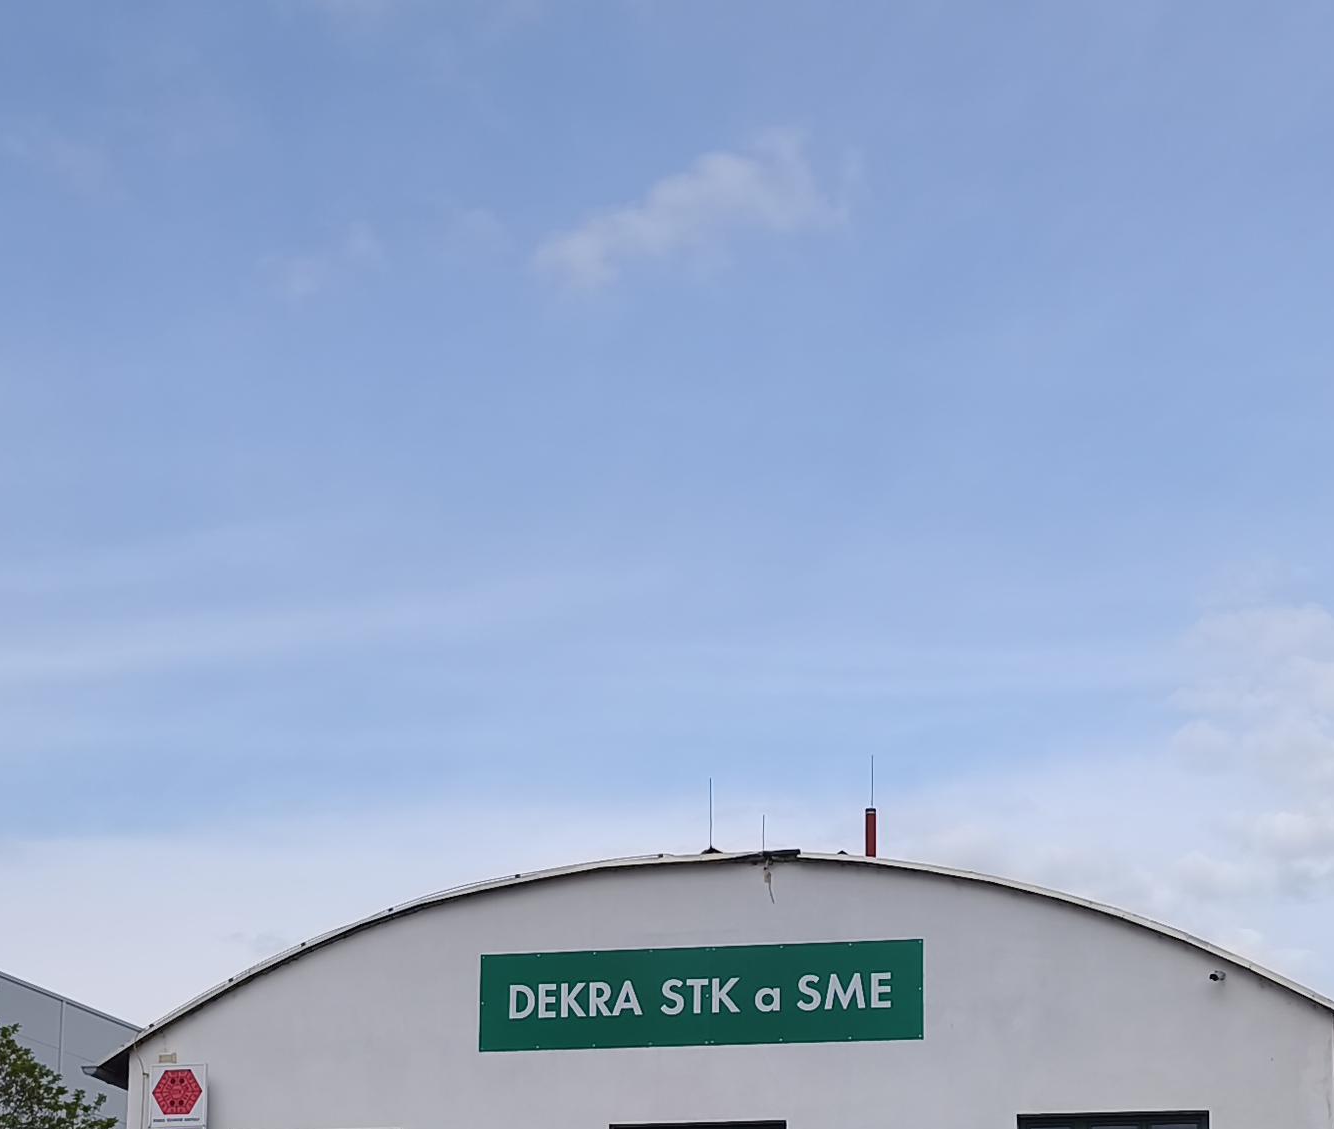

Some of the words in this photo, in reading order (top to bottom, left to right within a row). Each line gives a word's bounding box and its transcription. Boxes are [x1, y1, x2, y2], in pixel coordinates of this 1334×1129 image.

[508, 980, 643, 1020] DEKRA
[660, 977, 741, 1017] STK
[754, 987, 782, 1013] a
[796, 971, 892, 1012] SME
